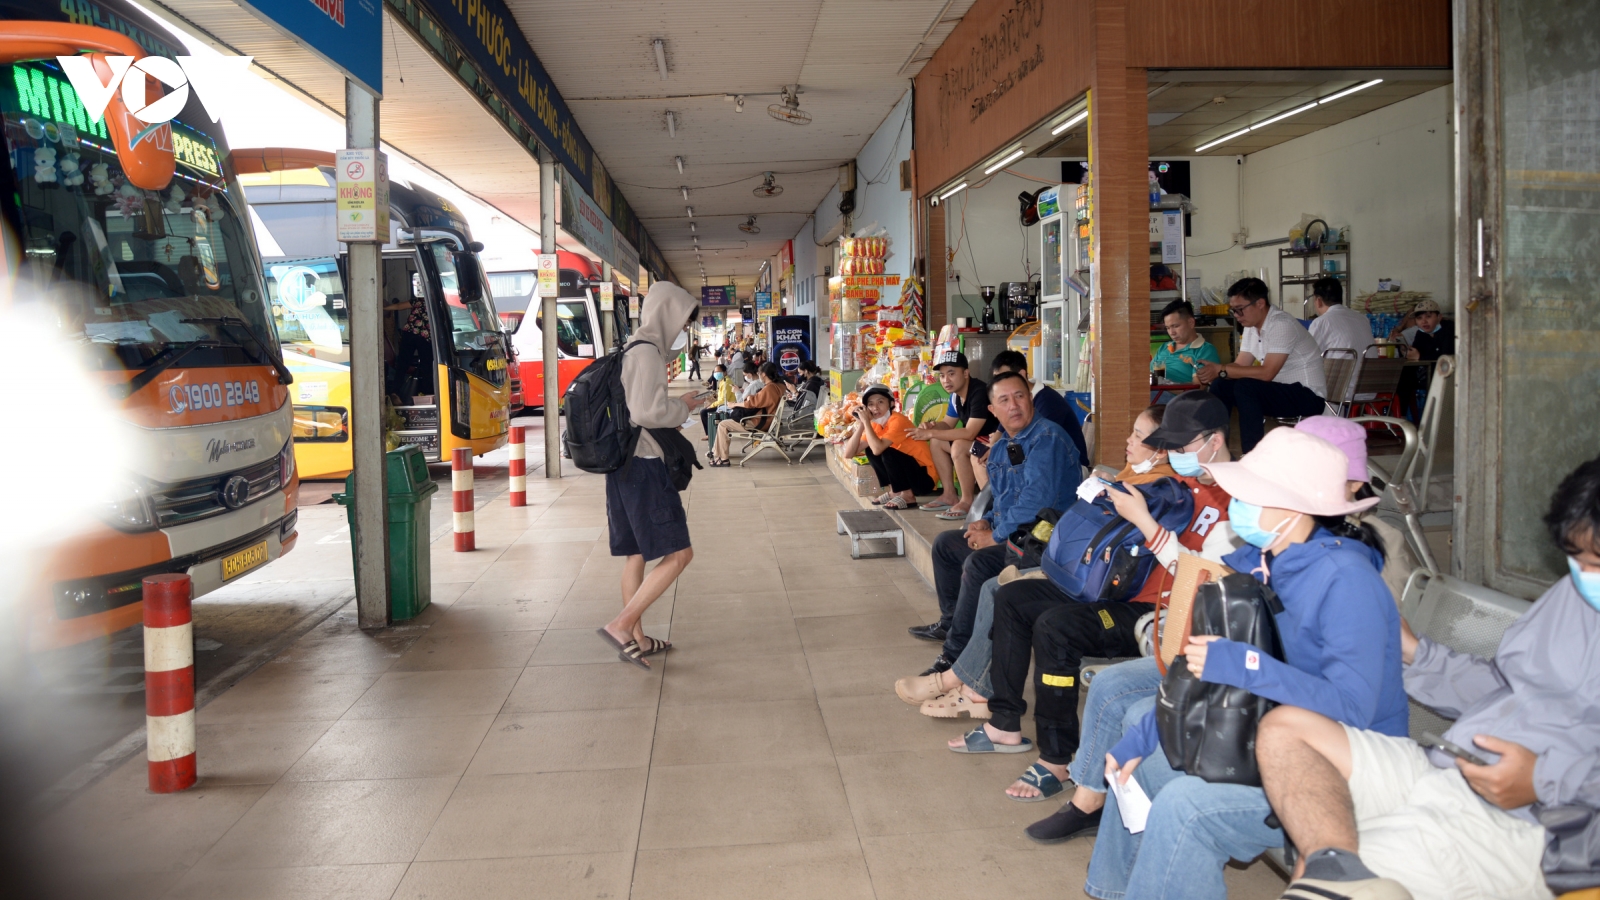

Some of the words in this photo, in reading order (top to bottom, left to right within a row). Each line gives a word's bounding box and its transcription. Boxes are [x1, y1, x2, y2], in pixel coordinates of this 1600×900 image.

[518, 58, 536, 112] LÂM
[538, 83, 558, 139] ĐỒNG
[562, 118, 577, 166] ĐỒNG
[172, 132, 217, 173] PRESS
[340, 183, 372, 200] KHÔNG
[776, 333, 802, 341] KHÁT
[184, 382, 222, 411] 1900
[224, 380, 260, 406] 2848
[1190, 505, 1220, 537] R
